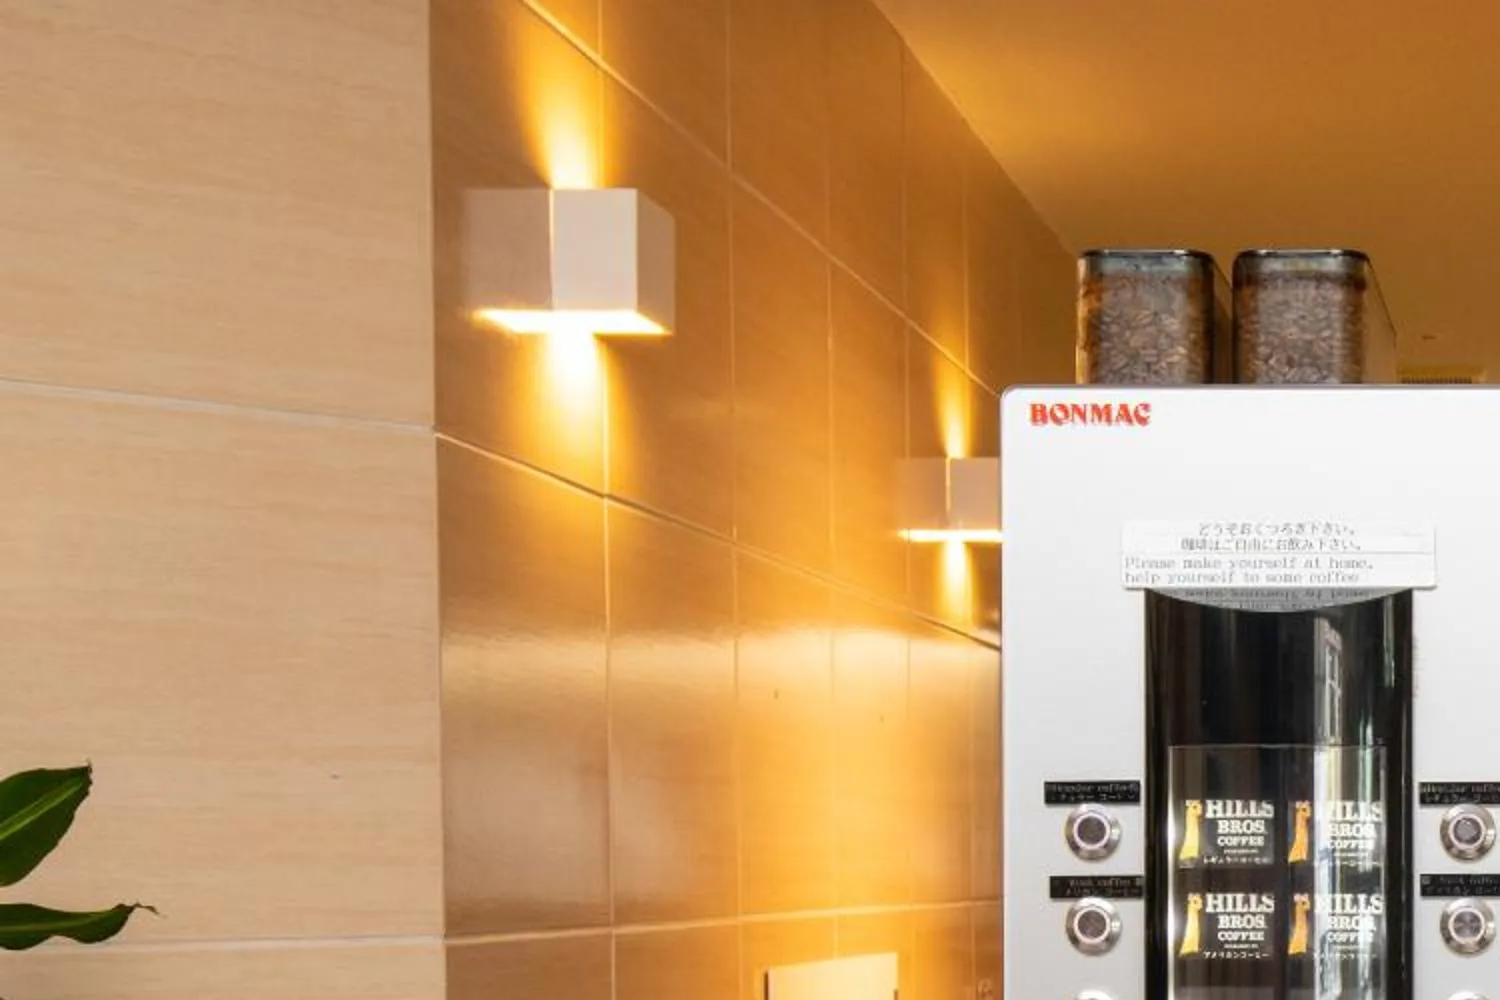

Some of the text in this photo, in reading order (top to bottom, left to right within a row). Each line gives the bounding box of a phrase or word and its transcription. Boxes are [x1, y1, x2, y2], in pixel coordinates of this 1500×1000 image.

[1030, 402, 1152, 426] BONMAC
[1124, 556, 1176, 569] Please
[1183, 556, 1222, 569] make
[1228, 556, 1298, 572] yourself
[1303, 557, 1320, 569] at
[1124, 571, 1359, 585] help yourself to some coffee
[1205, 799, 1275, 819] HILLS
[1217, 819, 1269, 834] BROS.
[1217, 835, 1265, 847] COFFEE
[1205, 893, 1275, 913] HILLS
[1217, 914, 1269, 929] BROS.
[1217, 931, 1265, 942] COFFEE
